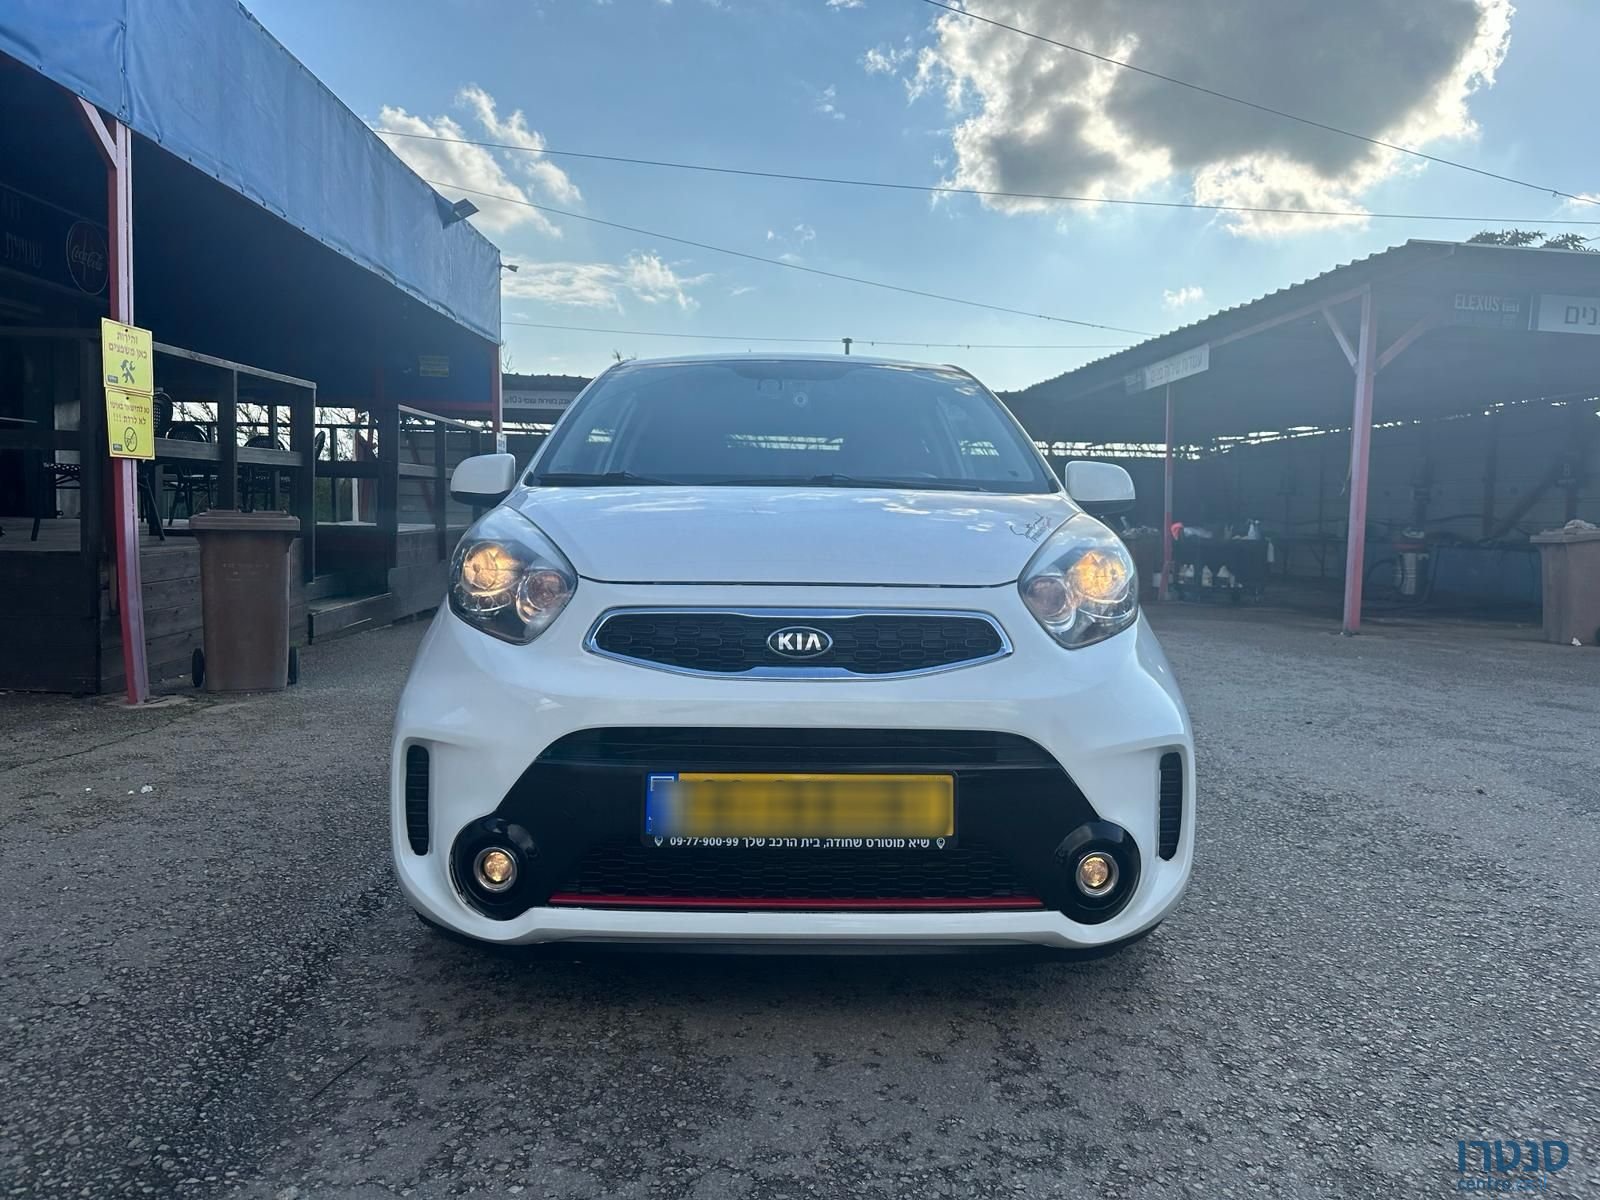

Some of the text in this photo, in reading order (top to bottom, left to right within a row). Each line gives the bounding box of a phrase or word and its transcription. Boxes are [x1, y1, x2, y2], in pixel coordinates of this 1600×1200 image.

[1454, 293, 1500, 312] ELEXUS
[1564, 303, 1600, 326] נים
[777, 632, 823, 651] KIA
[670, 836, 739, 847] 09-77-900-99
[742, 836, 766, 848] שלך
[768, 837, 798, 847] הרכב
[800, 838, 821, 848] בית
[866, 838, 905, 848] מוטורס
[908, 838, 930, 848] שיא
